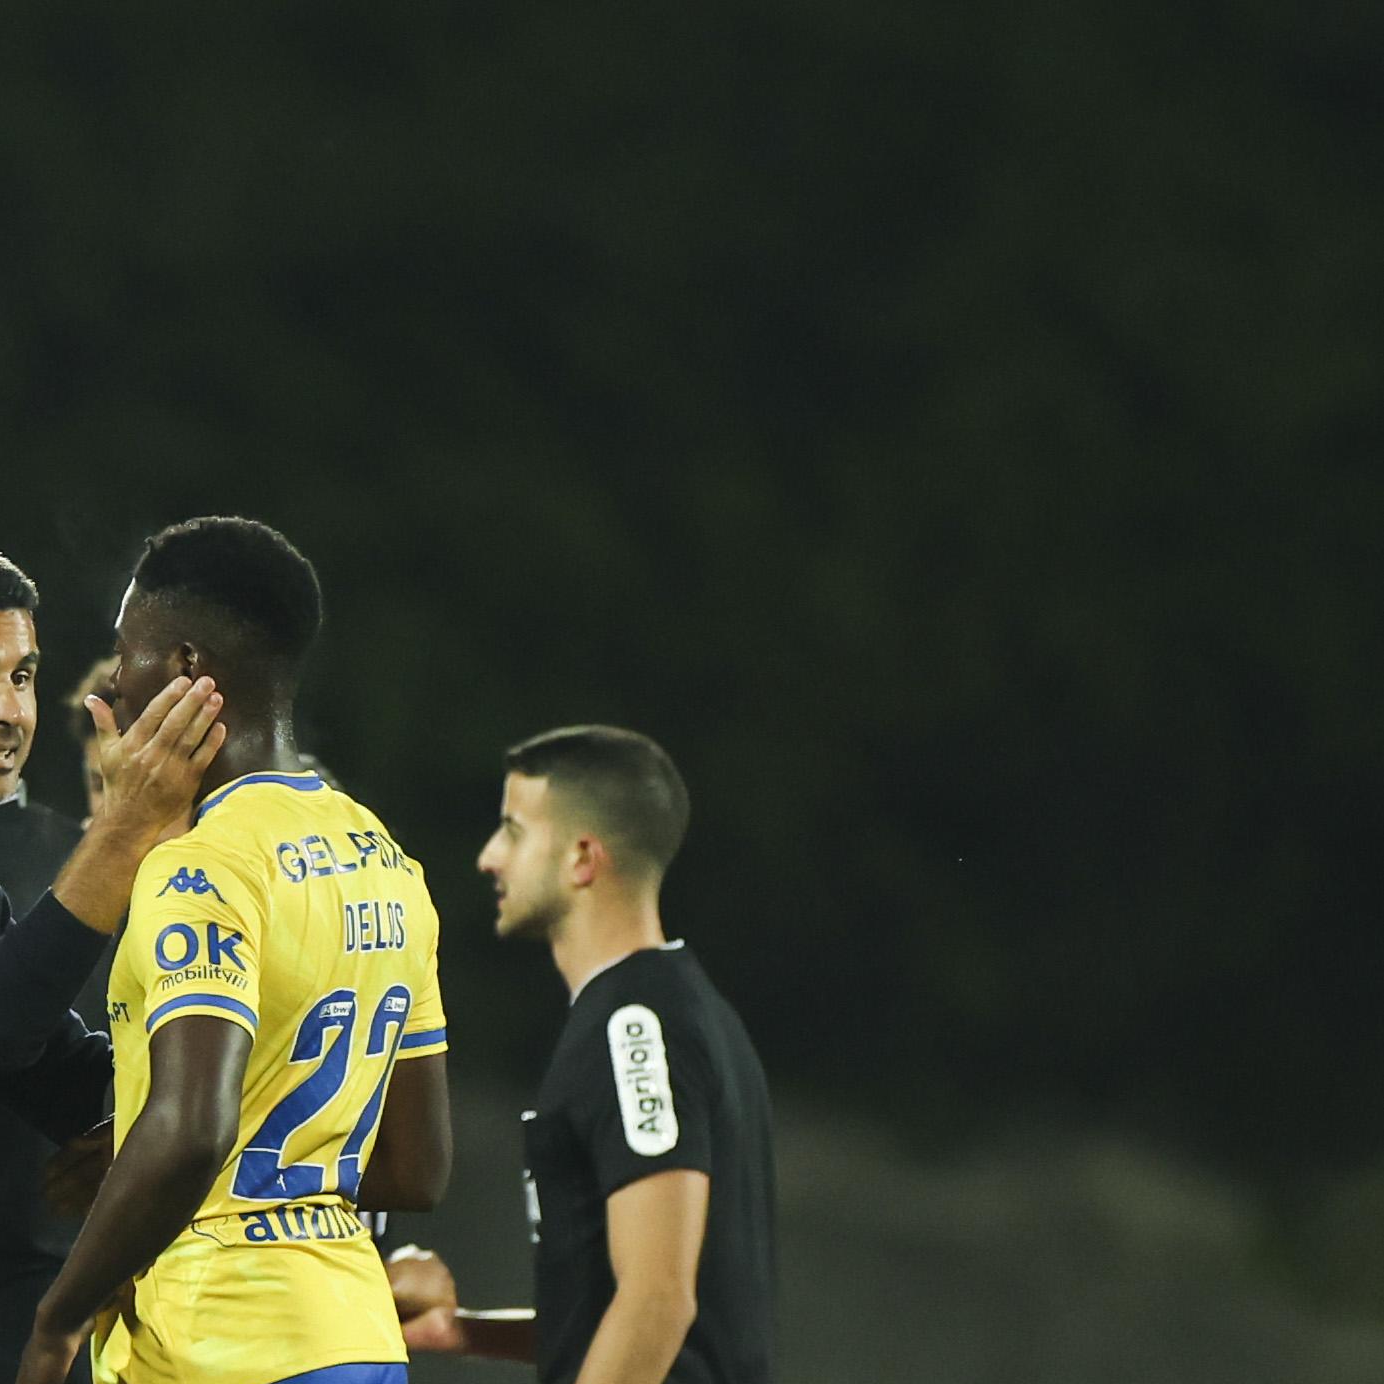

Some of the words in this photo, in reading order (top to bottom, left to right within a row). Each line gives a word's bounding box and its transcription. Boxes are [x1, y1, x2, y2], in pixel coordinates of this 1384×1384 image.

[155, 921, 247, 972] OK
[231, 984, 413, 1203] 22
[622, 1022, 663, 1134] Agriloja
